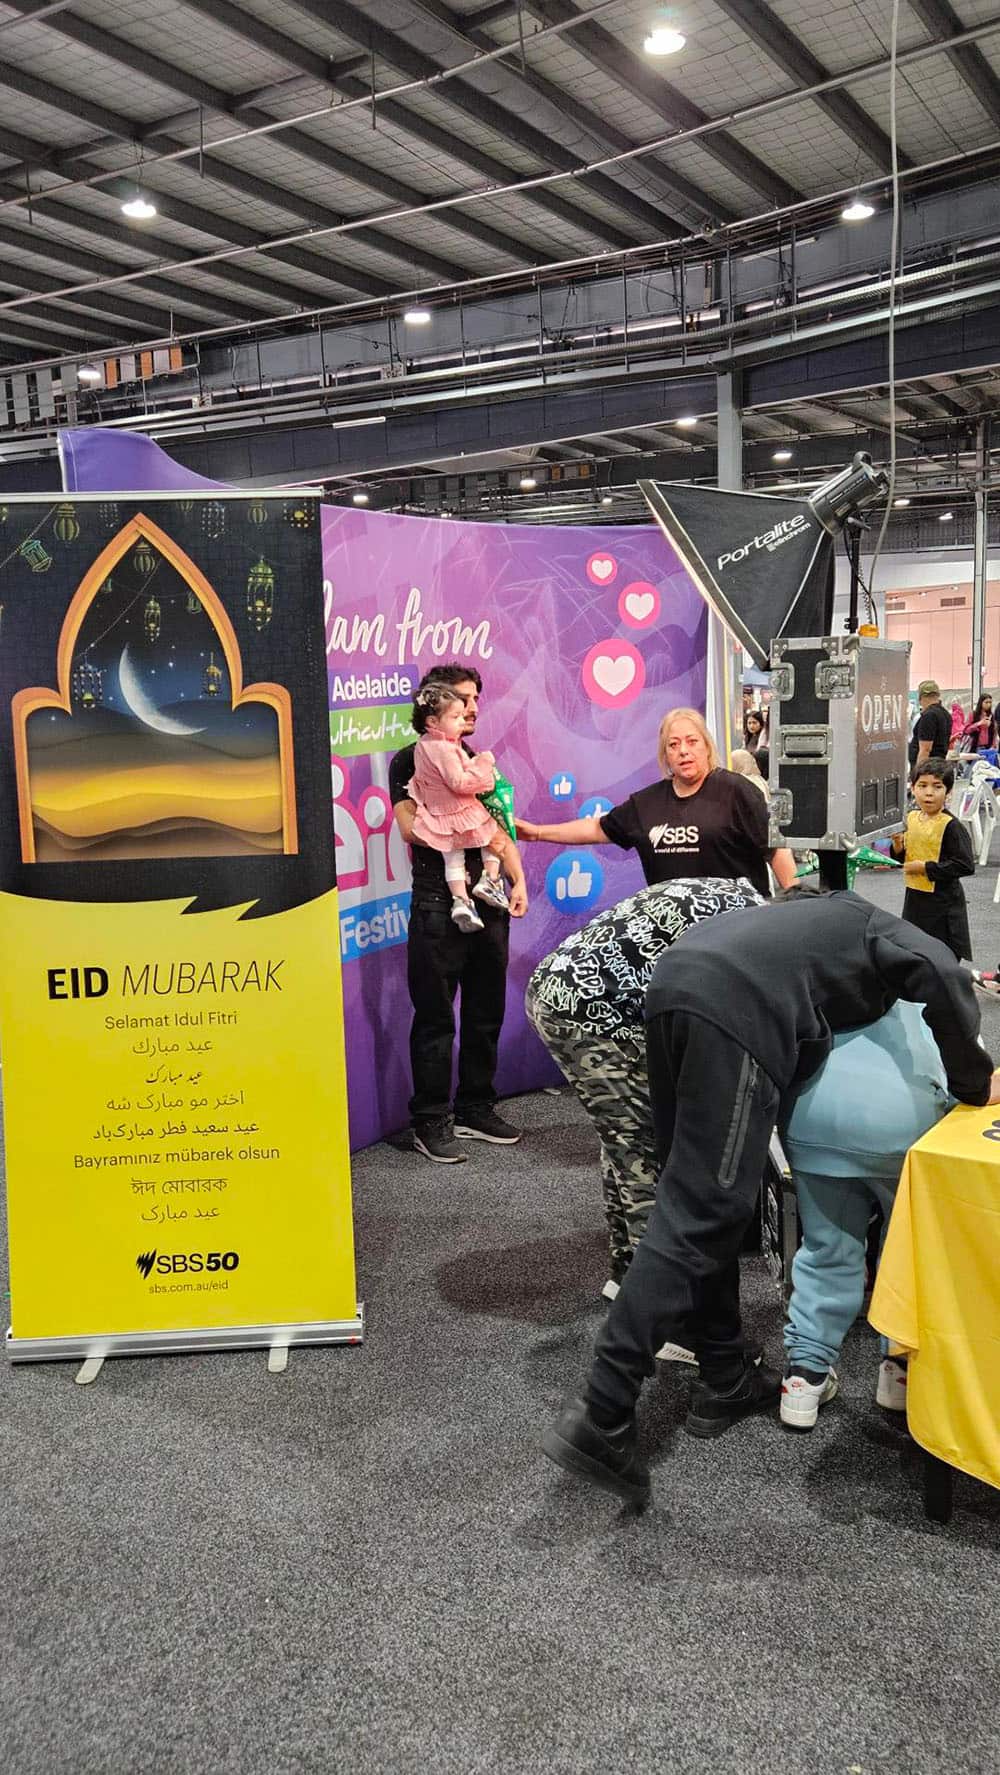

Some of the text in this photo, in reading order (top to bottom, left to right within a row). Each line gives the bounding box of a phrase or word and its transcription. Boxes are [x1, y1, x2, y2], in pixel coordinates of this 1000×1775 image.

[717, 514, 805, 571] Portalite
[323, 580, 493, 665] lam from
[332, 672, 412, 702] Adelaide
[330, 711, 416, 745] ulticultu
[861, 694, 903, 732] OPEN
[662, 826, 699, 845] SBS
[340, 902, 409, 955] Festiv
[47, 959, 286, 1000] EID MUBARAK
[104, 1011, 237, 1030] Selamat Idul Fitri
[74, 1145, 280, 1170] Bayramınız mübarek olsun
[162, 1178, 228, 1194] মোবারক
[149, 1280, 229, 1294] sbs.com.au/eid
